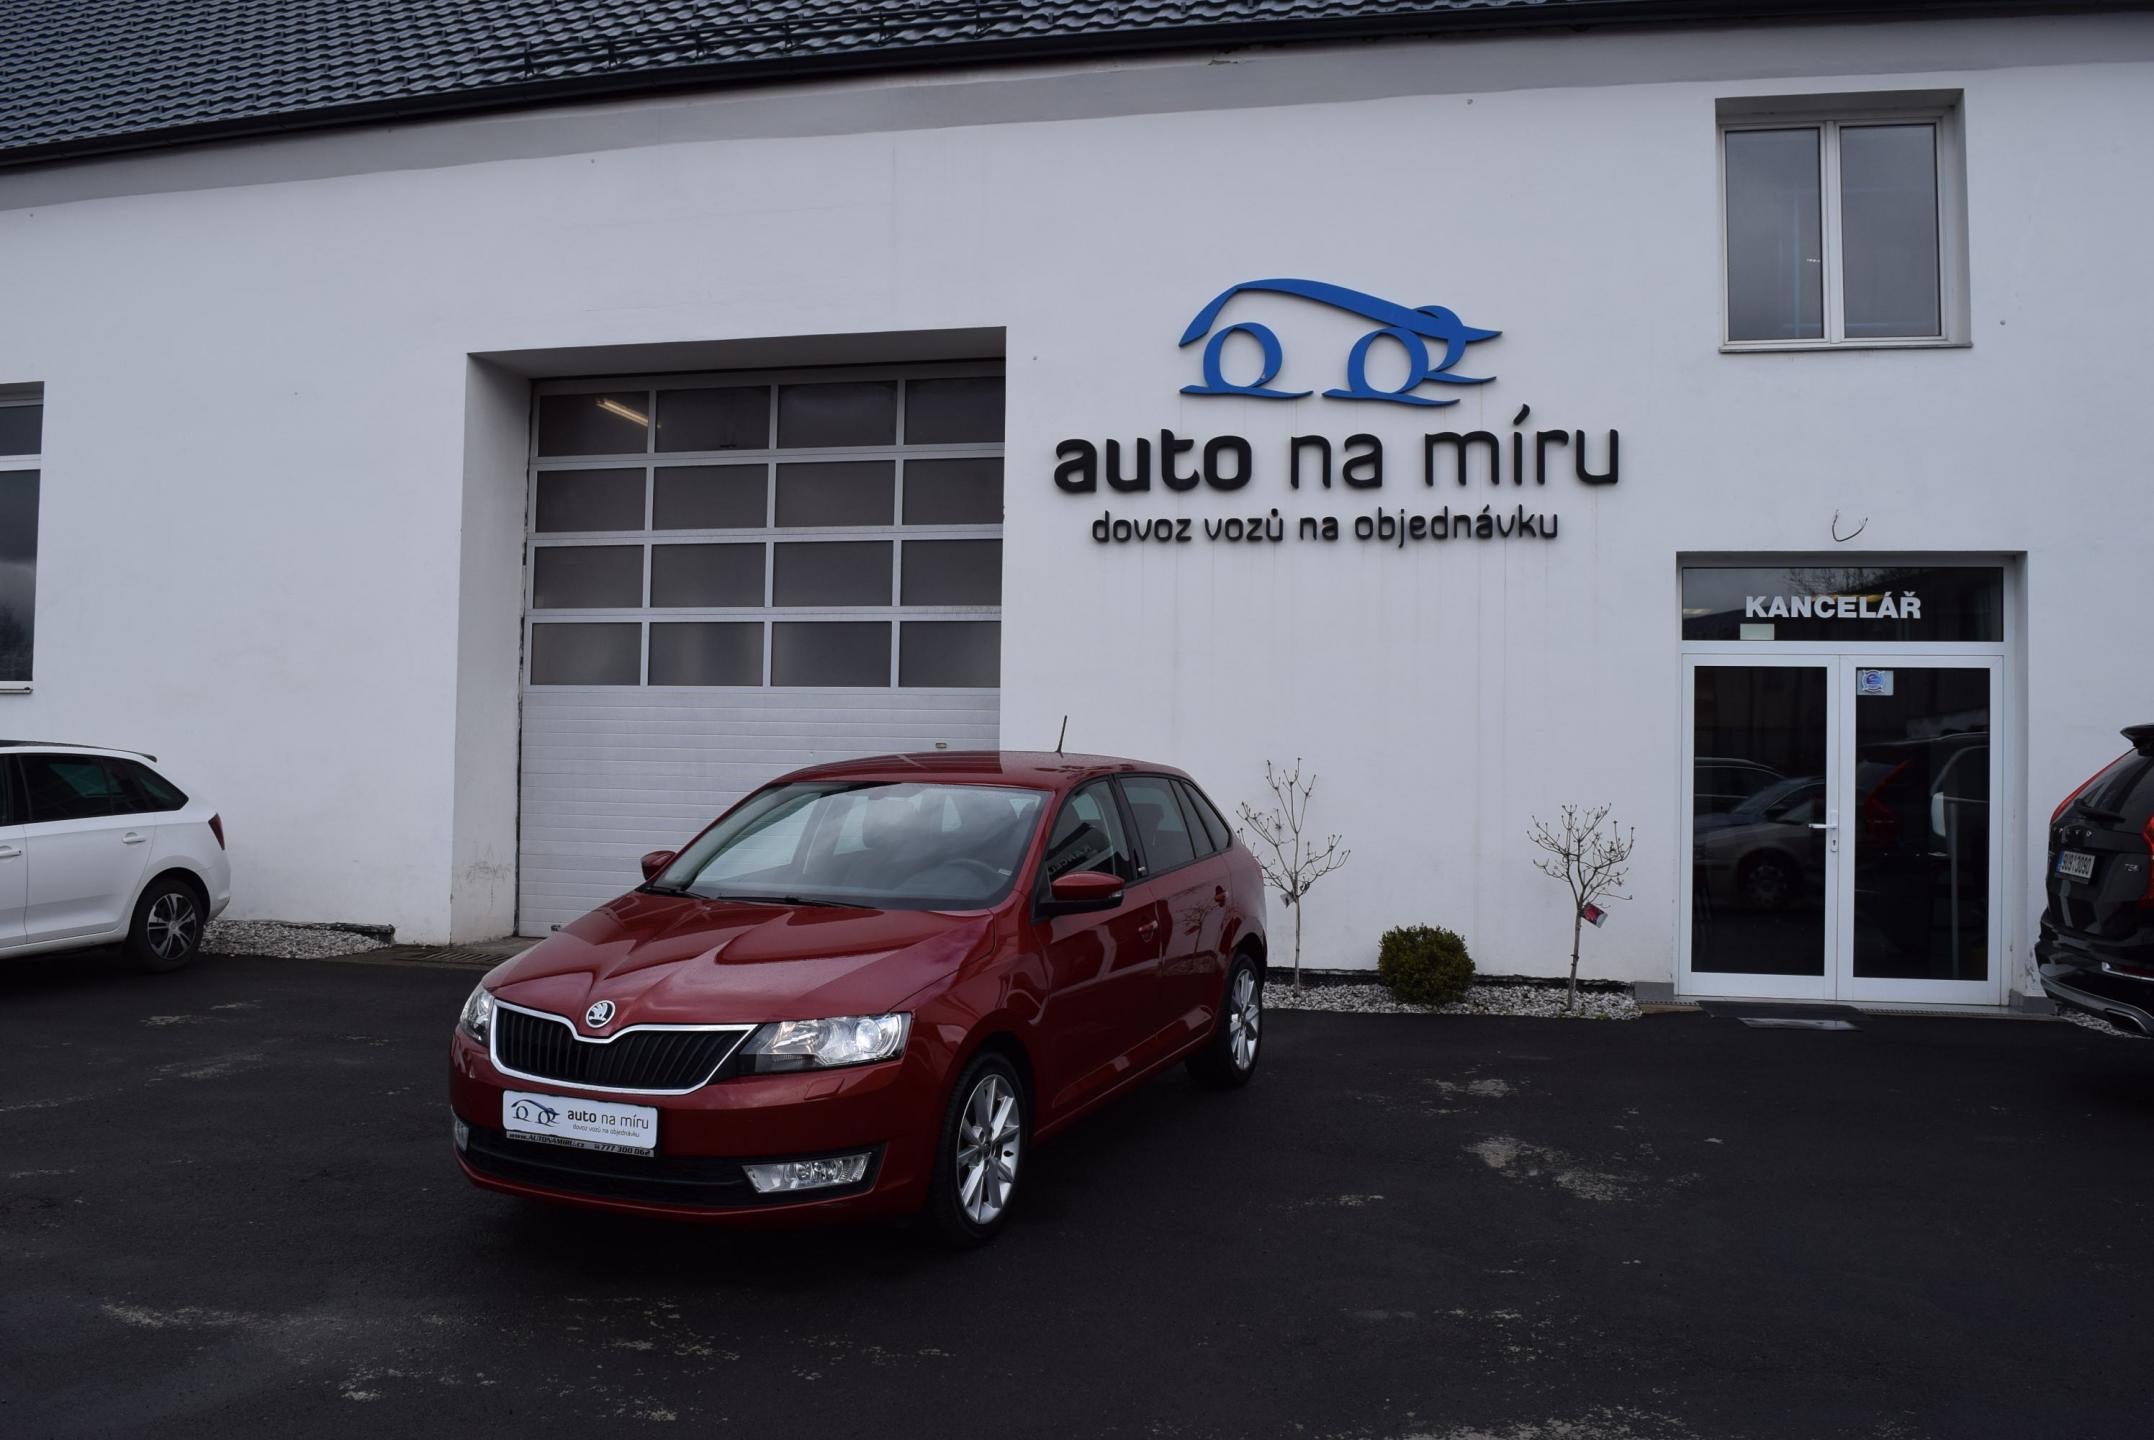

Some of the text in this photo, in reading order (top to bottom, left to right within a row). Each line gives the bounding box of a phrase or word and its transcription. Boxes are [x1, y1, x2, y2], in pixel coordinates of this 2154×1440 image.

[1054, 402, 1619, 495] auto na míru
[1092, 503, 1558, 548] dovoz vozů na objednávku
[1745, 591, 1921, 619] KANCELÁŘ
[567, 1109, 649, 1129] auto na míru
